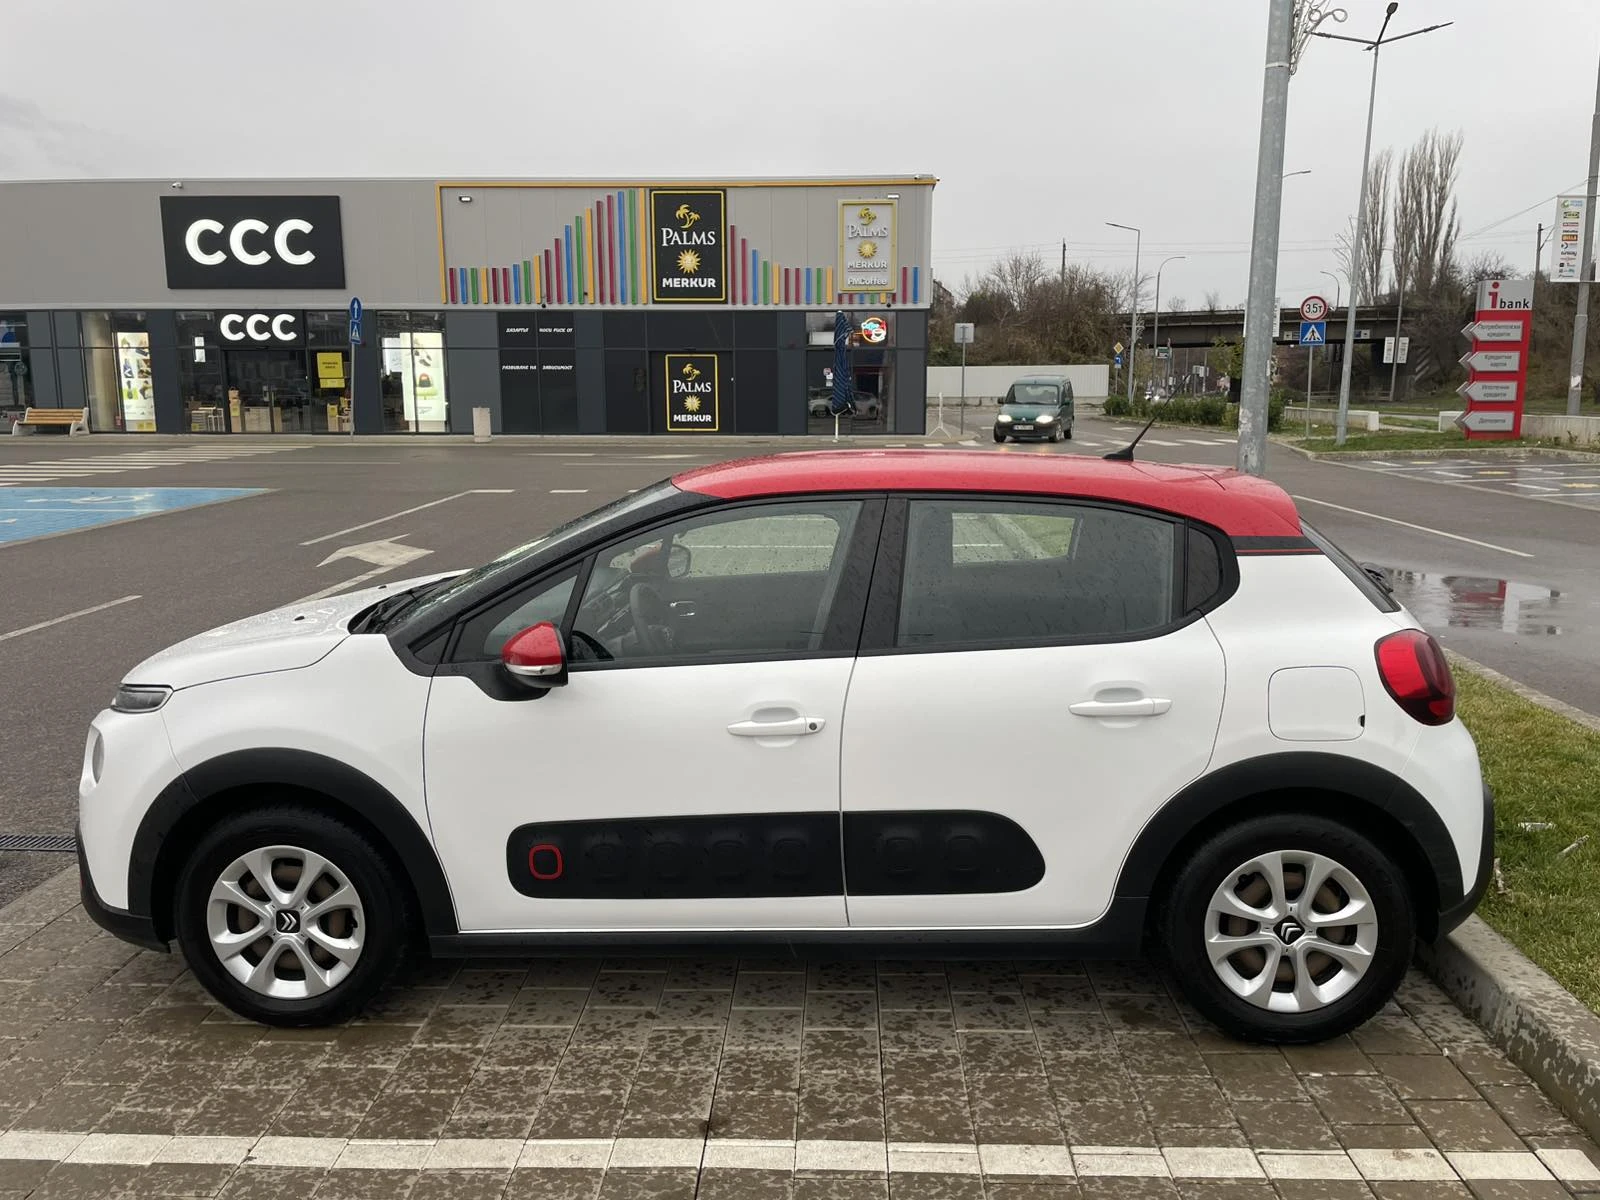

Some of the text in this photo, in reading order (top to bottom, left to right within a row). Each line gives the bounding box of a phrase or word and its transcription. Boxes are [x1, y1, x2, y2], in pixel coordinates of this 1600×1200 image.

[185, 218, 316, 266] CCC
[661, 227, 716, 247] PALMS
[847, 260, 888, 270] MERKUR
[662, 277, 717, 288] MERKUR
[219, 313, 297, 342] CCC
[673, 379, 712, 394] PALMS
[673, 414, 712, 422] MERKUR
